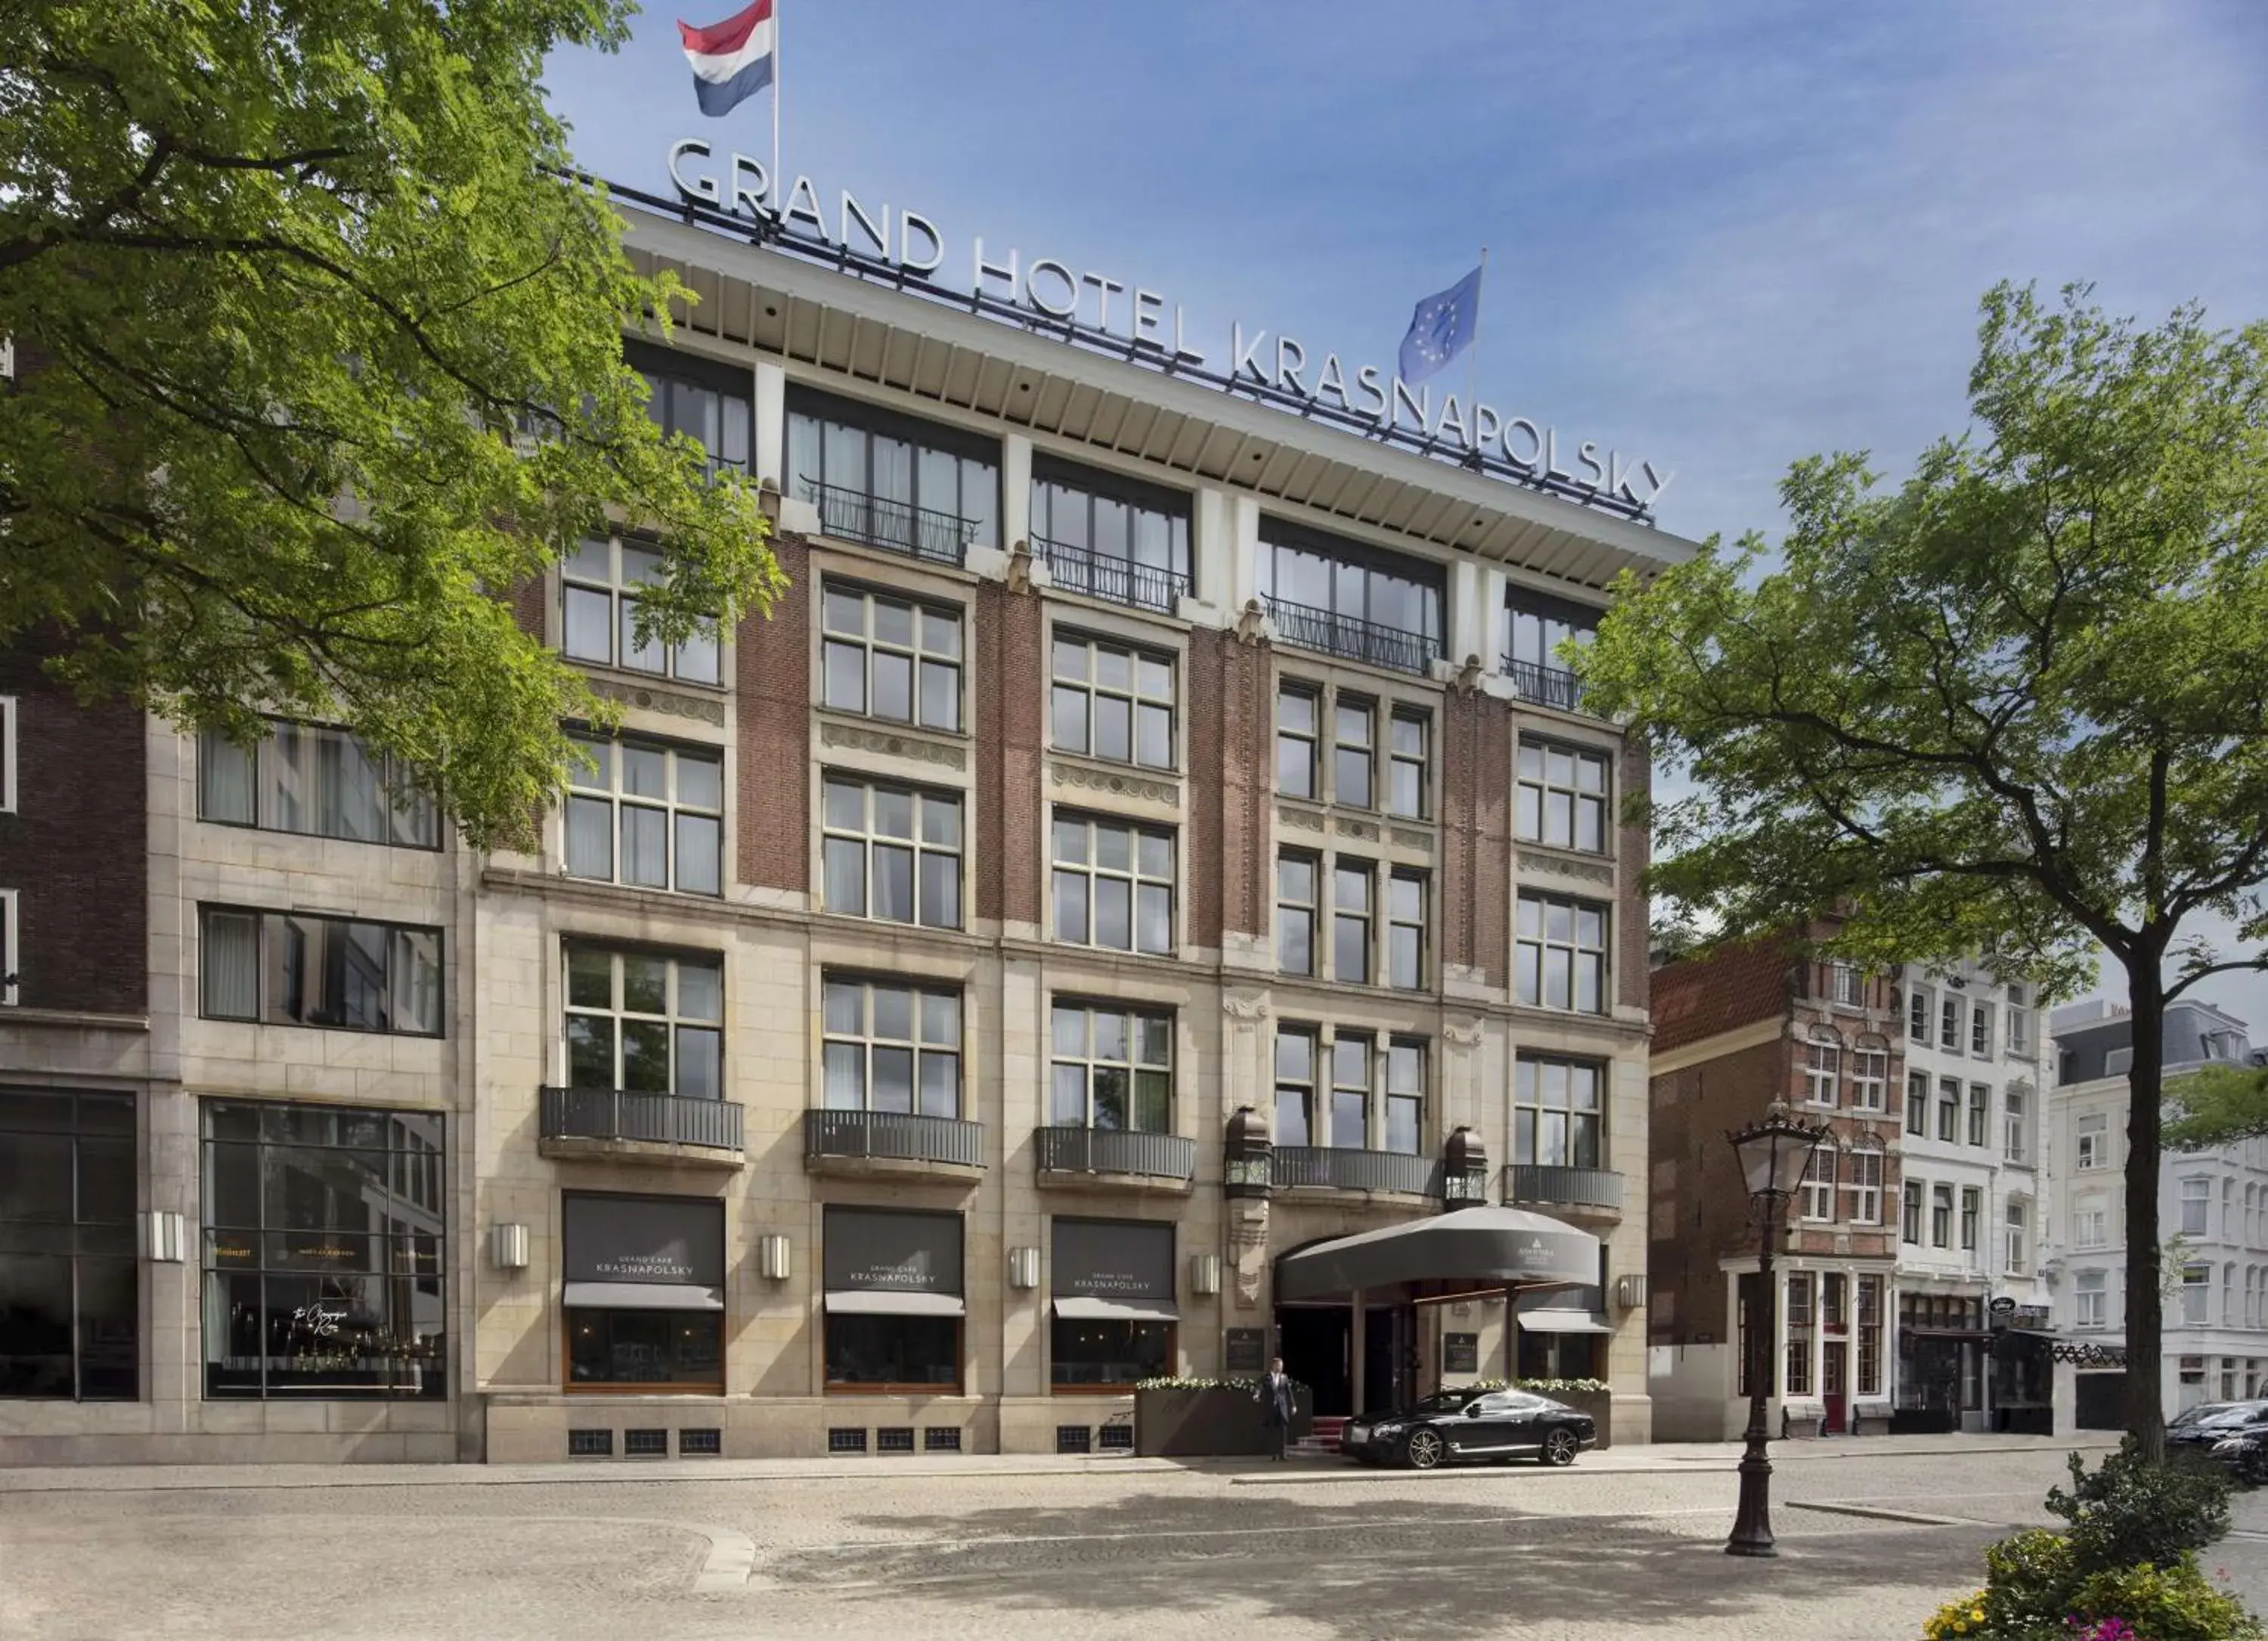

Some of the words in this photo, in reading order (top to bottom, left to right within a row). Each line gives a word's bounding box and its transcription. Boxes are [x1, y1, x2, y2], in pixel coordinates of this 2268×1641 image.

[668, 136, 945, 274] GRAND
[973, 235, 1206, 365] HOTEL
[1232, 320, 1675, 505] KRASNAPOLSKY
[596, 1264, 693, 1274] KRASNAPOLSKY
[850, 1272, 935, 1283] KRASNAPOLSKY
